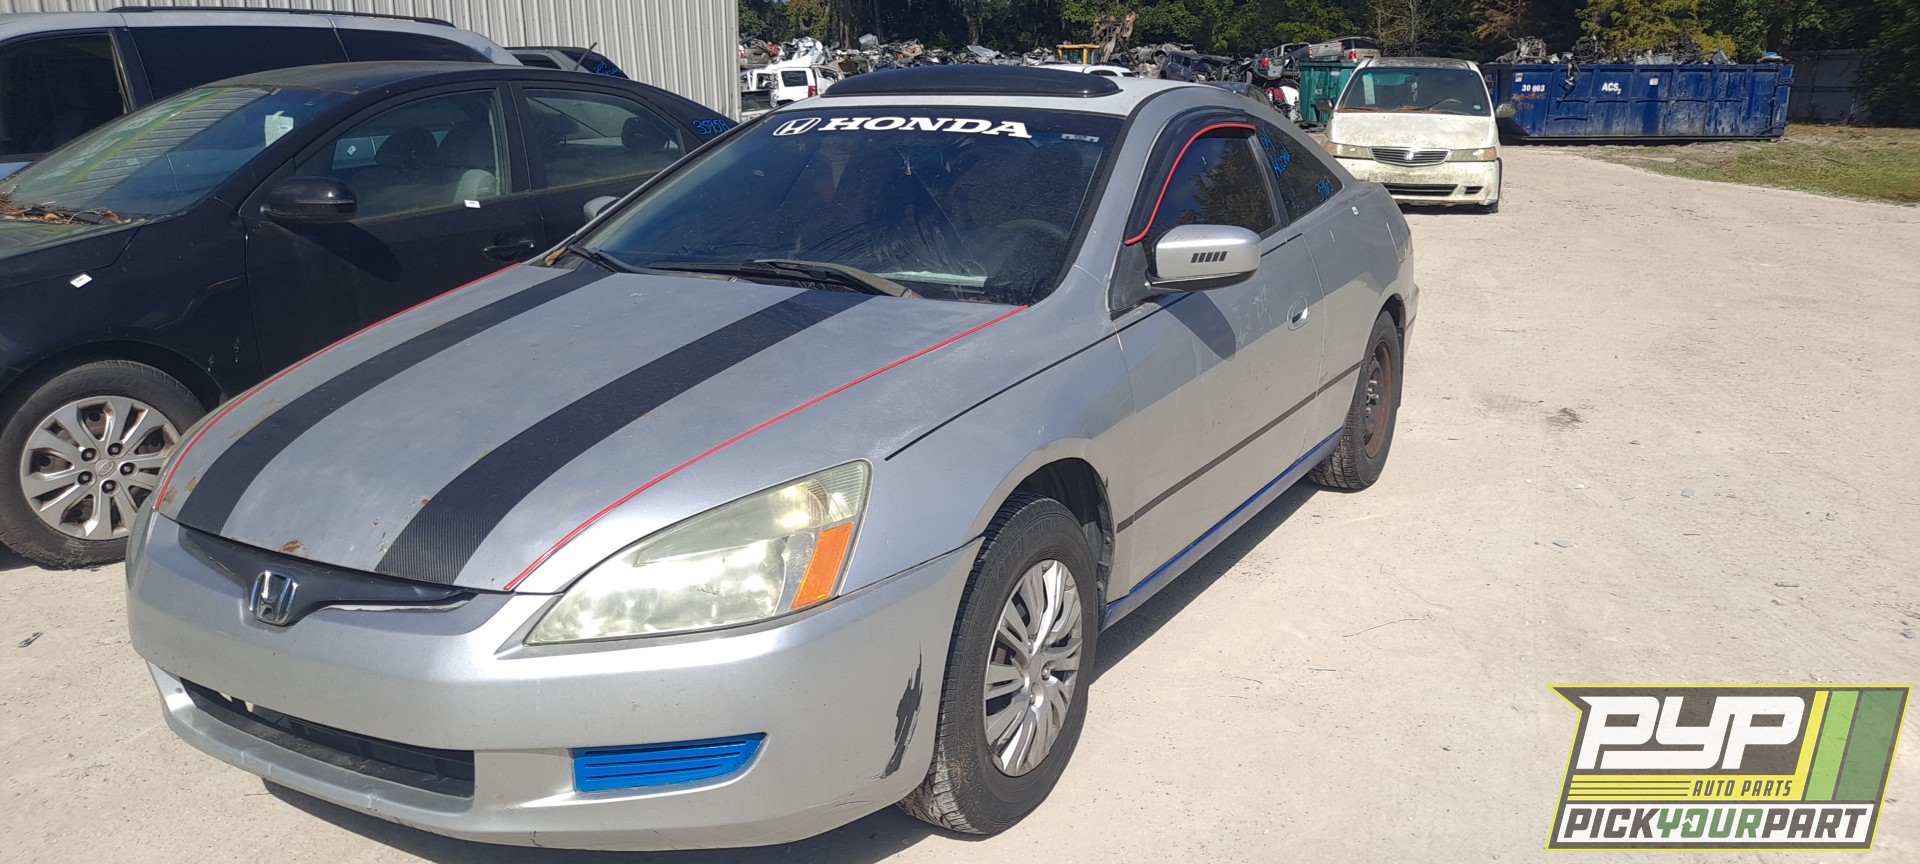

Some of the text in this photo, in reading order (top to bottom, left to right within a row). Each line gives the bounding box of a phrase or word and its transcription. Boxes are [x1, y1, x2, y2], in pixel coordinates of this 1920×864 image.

[1521, 84, 1546, 92] 30 003
[817, 117, 1033, 140] HONDA
